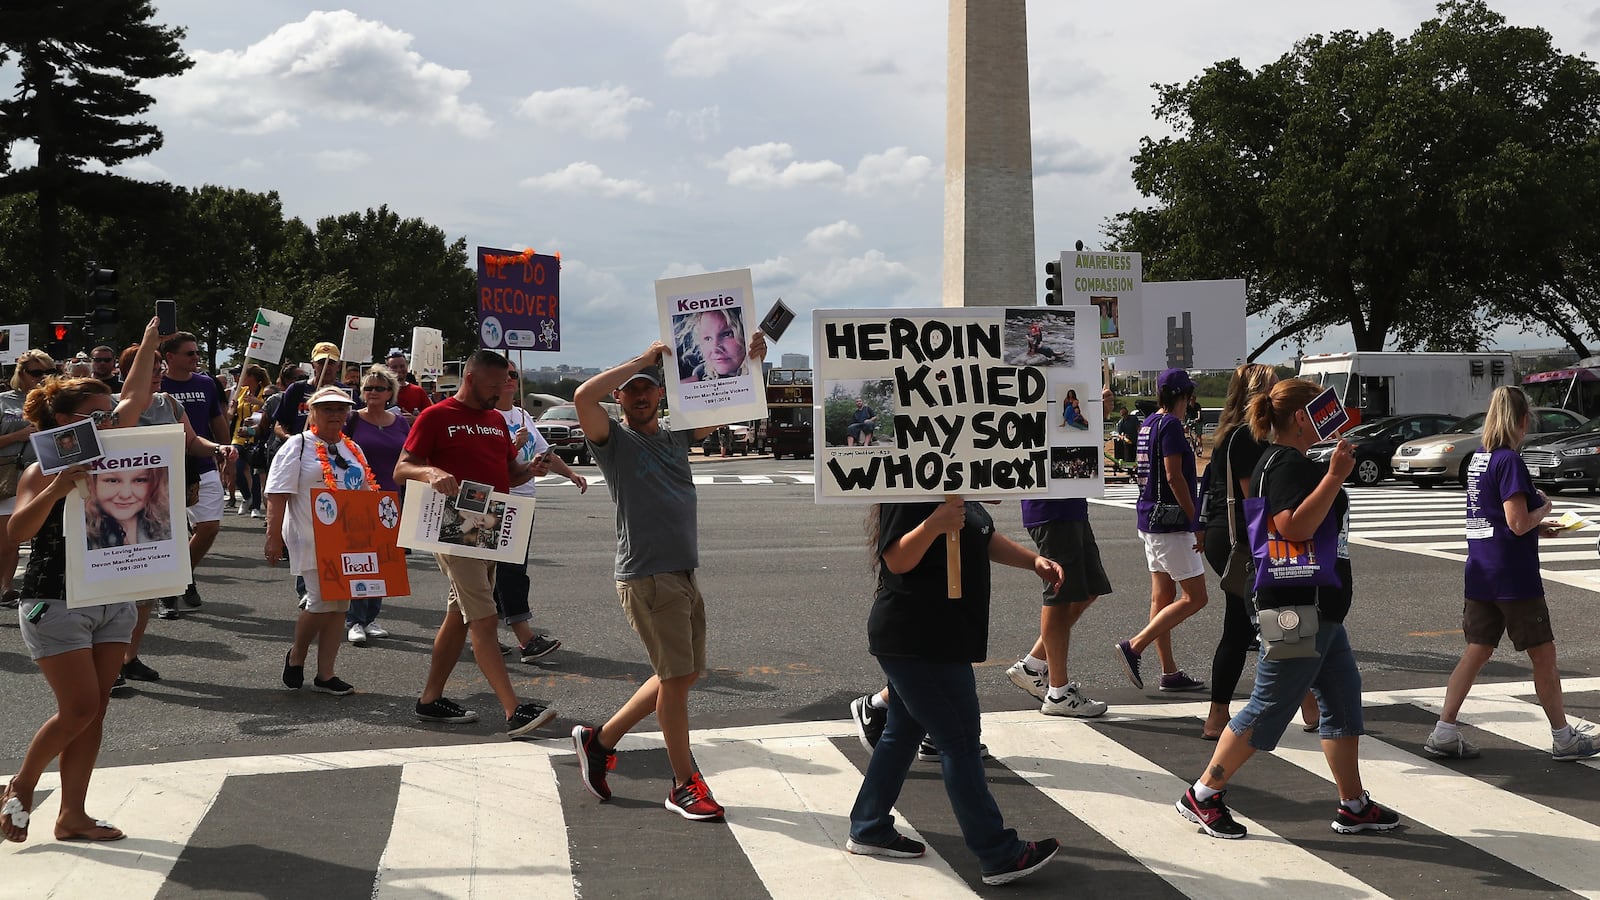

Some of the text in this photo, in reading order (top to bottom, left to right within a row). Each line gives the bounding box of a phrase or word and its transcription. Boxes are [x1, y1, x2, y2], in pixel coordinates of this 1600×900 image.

[1075, 254, 1131, 271] AWARENESS
[523, 261, 545, 285] DO
[1075, 277, 1133, 292] COMPASSION
[481, 287, 557, 318] RECOVER
[677, 294, 734, 312] Kenzie
[825, 318, 1001, 364] HEROIN
[476, 424, 504, 438] heroin
[971, 411, 1046, 450] SON
[92, 452, 162, 471] Kenzie
[500, 506, 517, 547] Kenzie
[116, 563, 148, 572] 1991-2016
[343, 555, 377, 573] Preach
